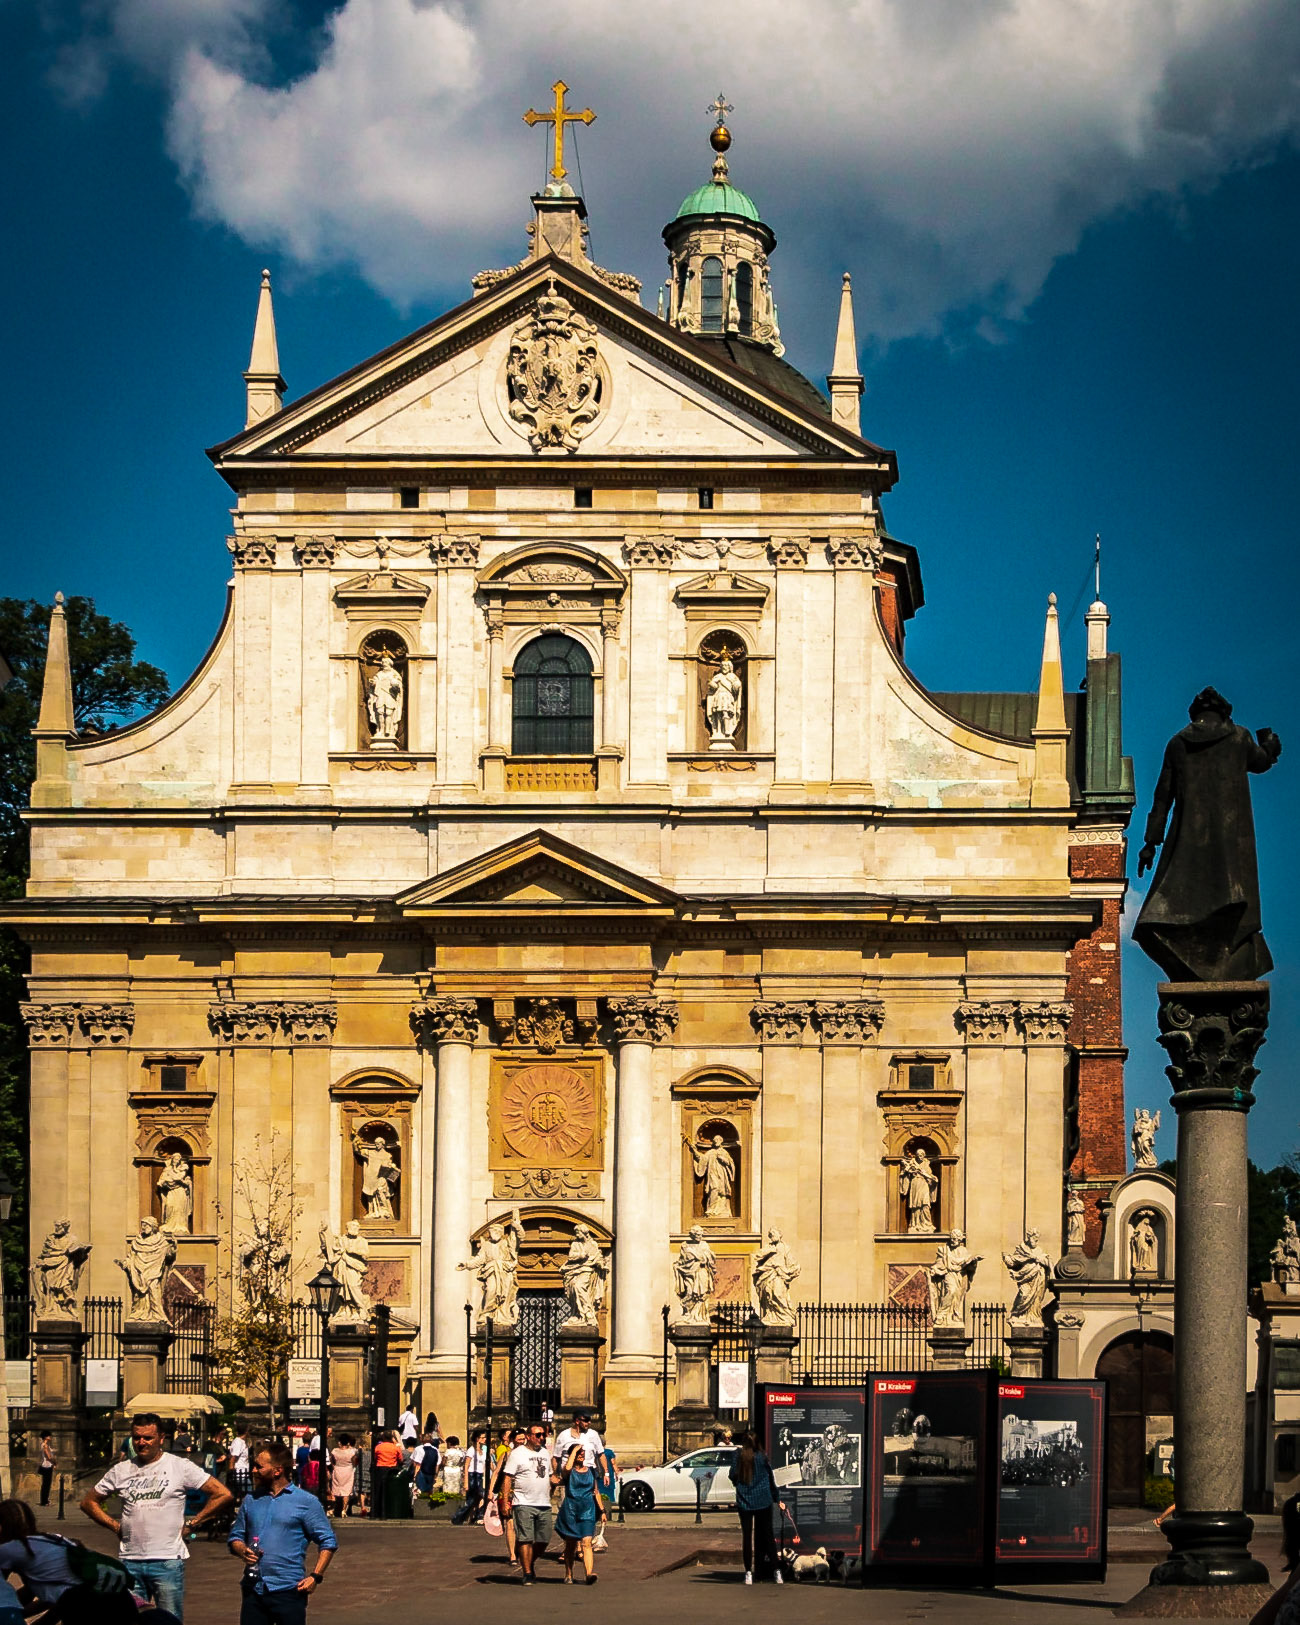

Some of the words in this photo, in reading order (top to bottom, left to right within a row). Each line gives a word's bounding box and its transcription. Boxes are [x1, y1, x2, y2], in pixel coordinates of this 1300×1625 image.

[888, 1383, 912, 1391] Kraków
[1004, 1387, 1022, 1396] Kraków
[775, 1394, 793, 1402] Kraków
[128, 1487, 165, 1504] Special
